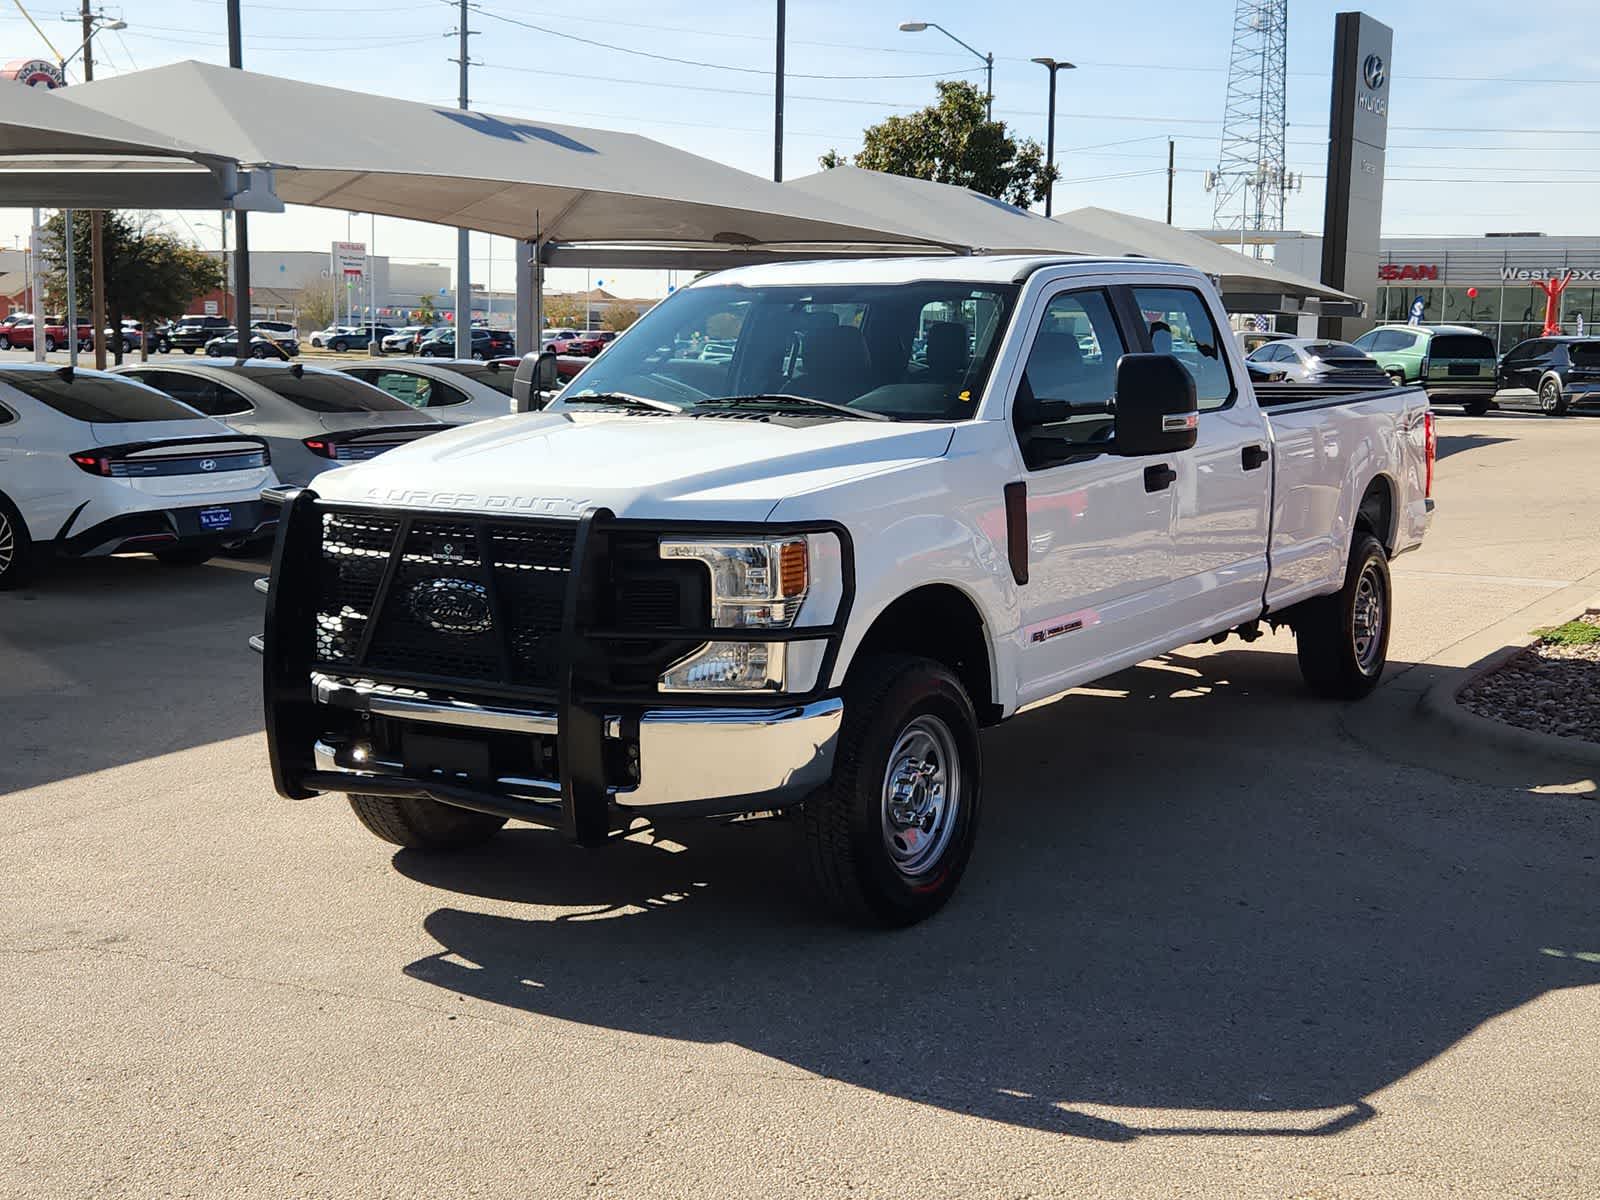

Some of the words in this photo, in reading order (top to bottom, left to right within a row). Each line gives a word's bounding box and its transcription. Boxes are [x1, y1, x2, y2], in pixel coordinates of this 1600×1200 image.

[1378, 265, 1437, 280] SAN
[1500, 267, 1549, 281] West
[484, 495, 593, 513] DUTY
